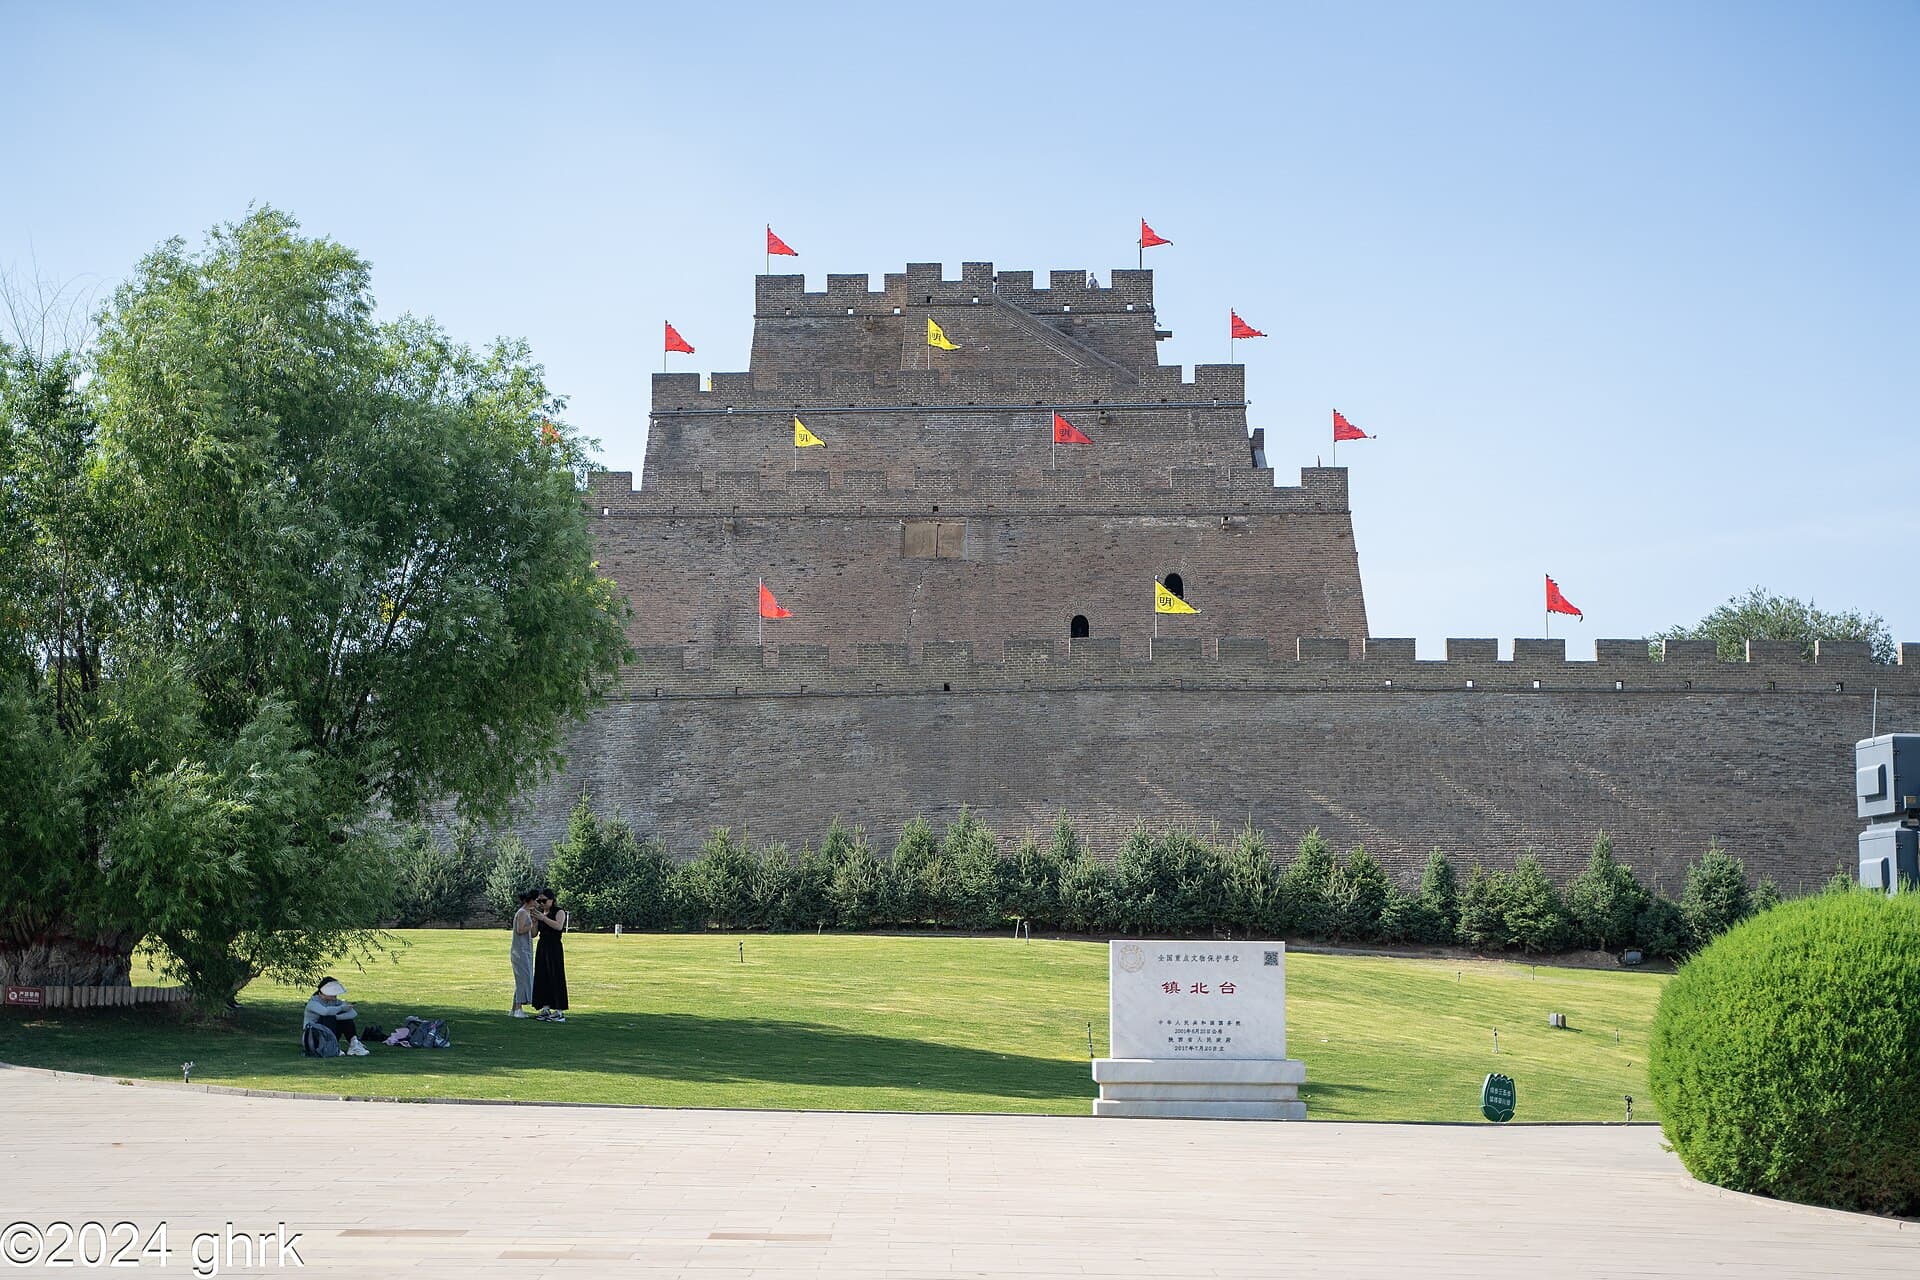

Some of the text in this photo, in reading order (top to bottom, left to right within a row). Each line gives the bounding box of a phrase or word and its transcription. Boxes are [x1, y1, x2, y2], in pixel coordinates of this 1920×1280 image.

[1159, 596, 1172, 607] 明
[1161, 981, 1237, 995] 镇北台
